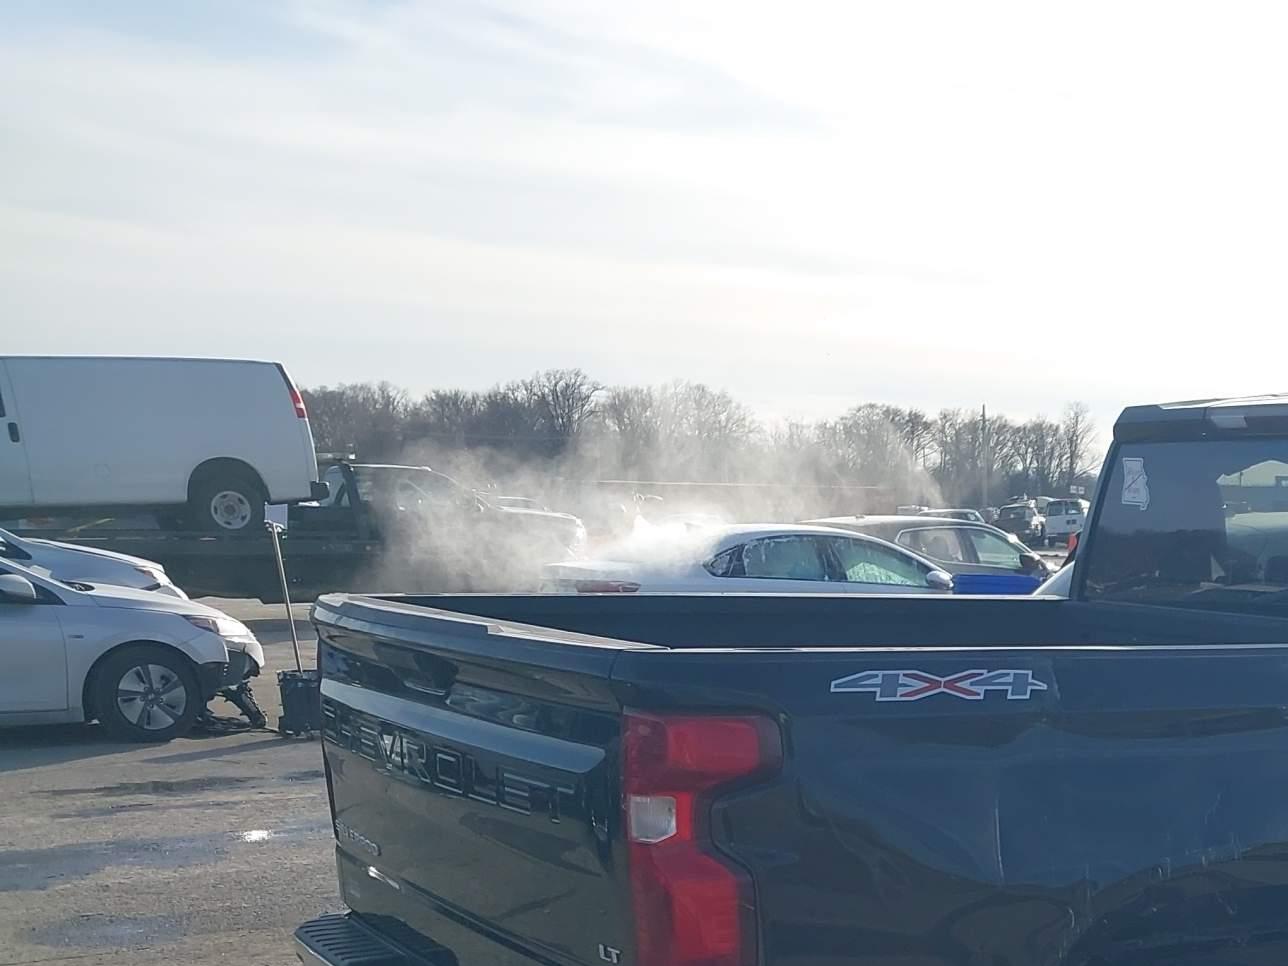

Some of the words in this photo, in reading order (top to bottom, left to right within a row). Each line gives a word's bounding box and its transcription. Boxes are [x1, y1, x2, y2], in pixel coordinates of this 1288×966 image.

[830, 669, 1049, 702] 4X4
[321, 701, 576, 824] CHEVROLET
[598, 943, 621, 964] LT
